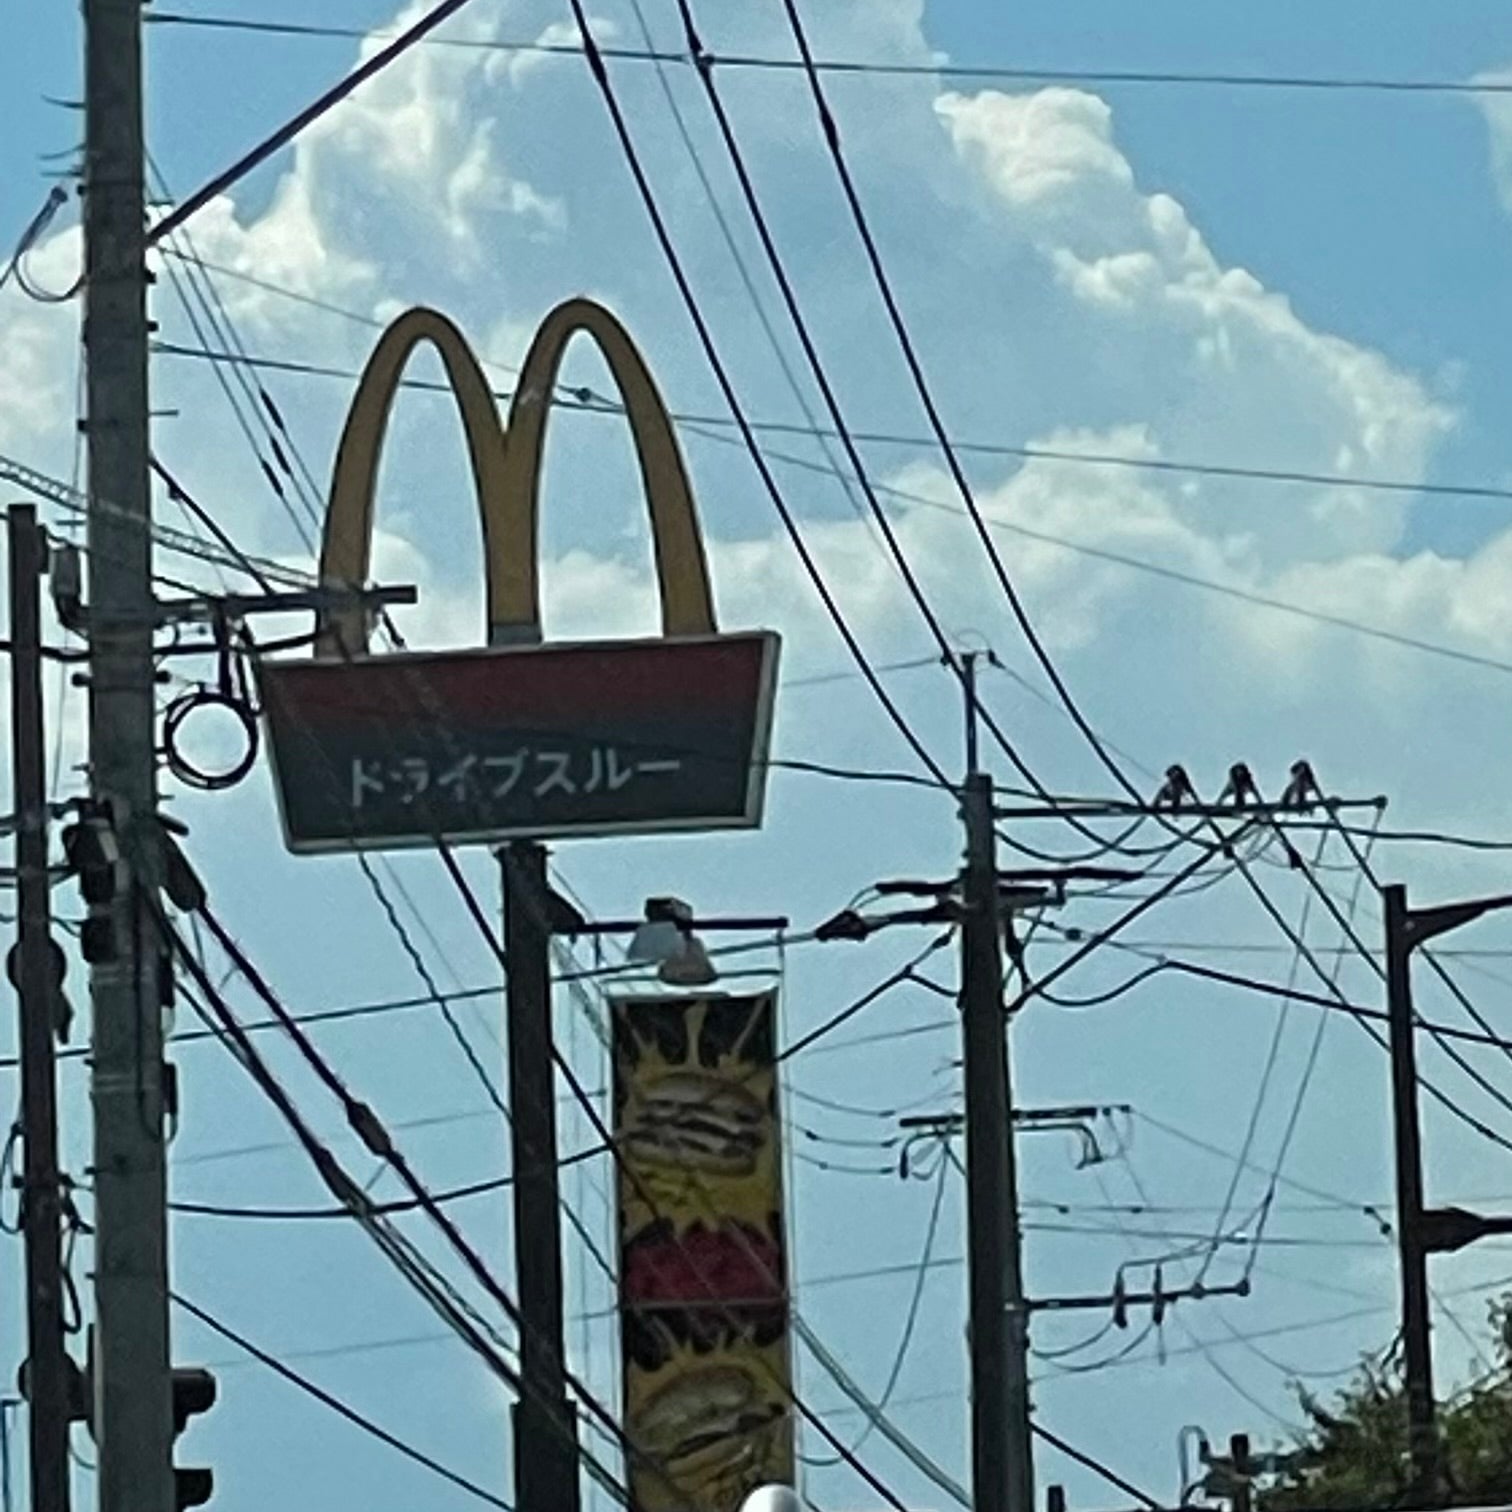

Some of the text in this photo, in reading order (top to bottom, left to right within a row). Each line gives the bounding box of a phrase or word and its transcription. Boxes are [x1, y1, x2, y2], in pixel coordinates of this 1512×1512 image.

[352, 746, 681, 806] ドライブスルー
